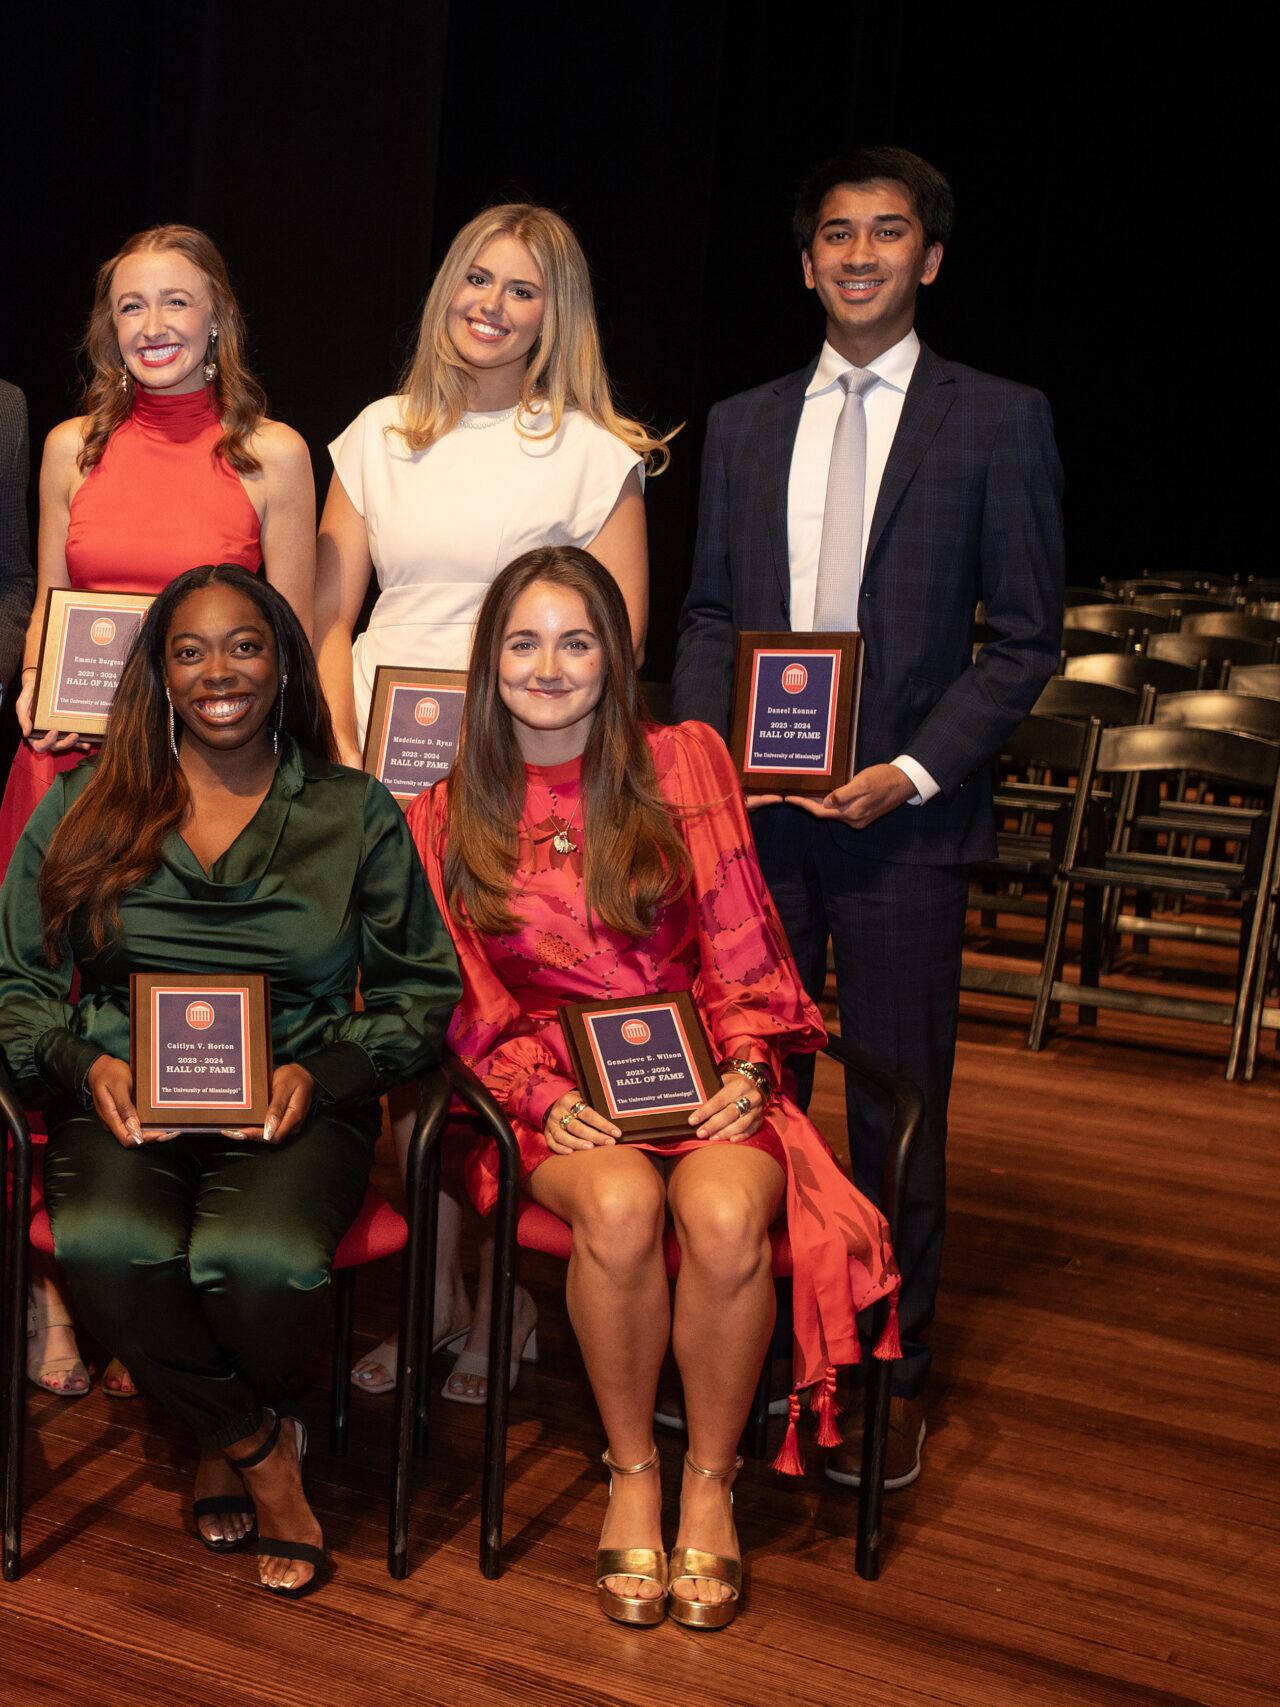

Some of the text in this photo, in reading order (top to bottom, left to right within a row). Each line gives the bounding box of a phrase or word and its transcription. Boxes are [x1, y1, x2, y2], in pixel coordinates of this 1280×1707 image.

[607, 1057, 644, 1066] Genevieve
[616, 1078, 642, 1086] HALL
[659, 1072, 684, 1081] FAME
